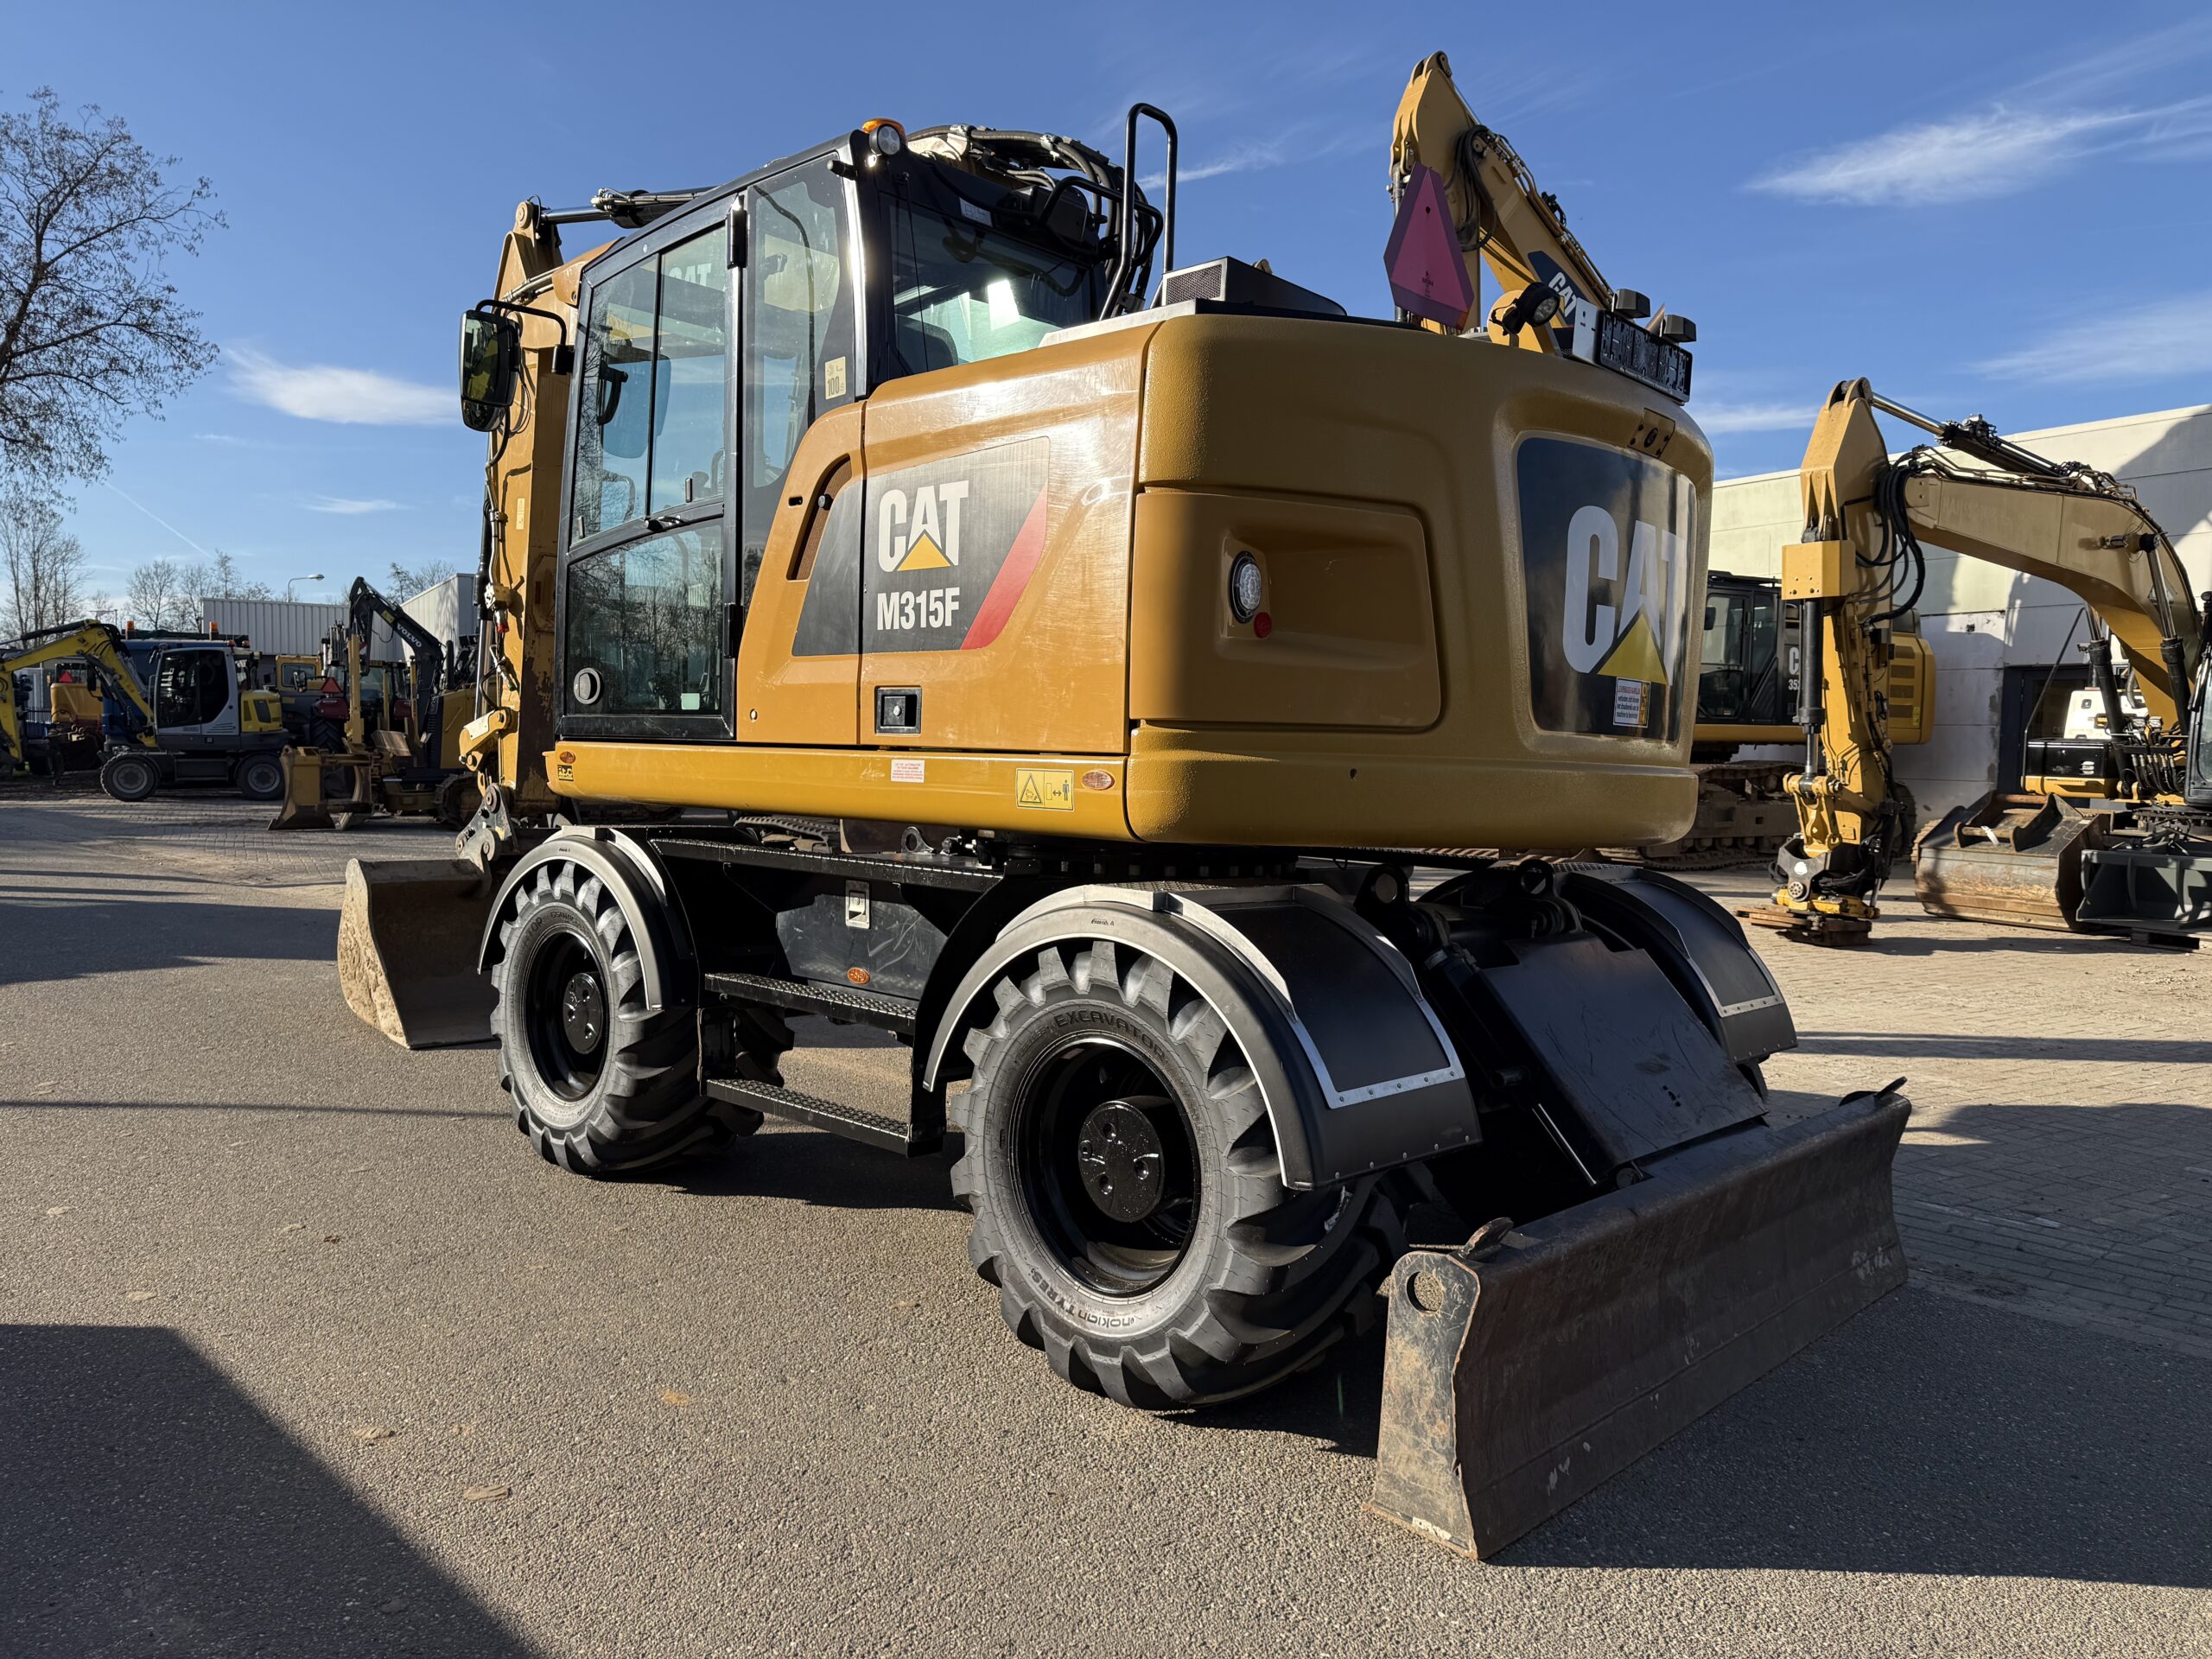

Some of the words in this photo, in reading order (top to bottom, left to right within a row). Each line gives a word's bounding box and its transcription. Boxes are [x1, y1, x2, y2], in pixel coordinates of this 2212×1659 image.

[1548, 272, 1577, 317] CAT
[828, 377, 839, 396] 100
[879, 480, 968, 572] CAT
[878, 588, 959, 630] M315F
[1562, 505, 1685, 685] CAT
[397, 622, 422, 647] VOLVO
[1053, 1009, 1166, 1062] EXCAVATOR
[1032, 1268, 1076, 1316] TYRES
[1077, 1306, 1132, 1328] nokian
